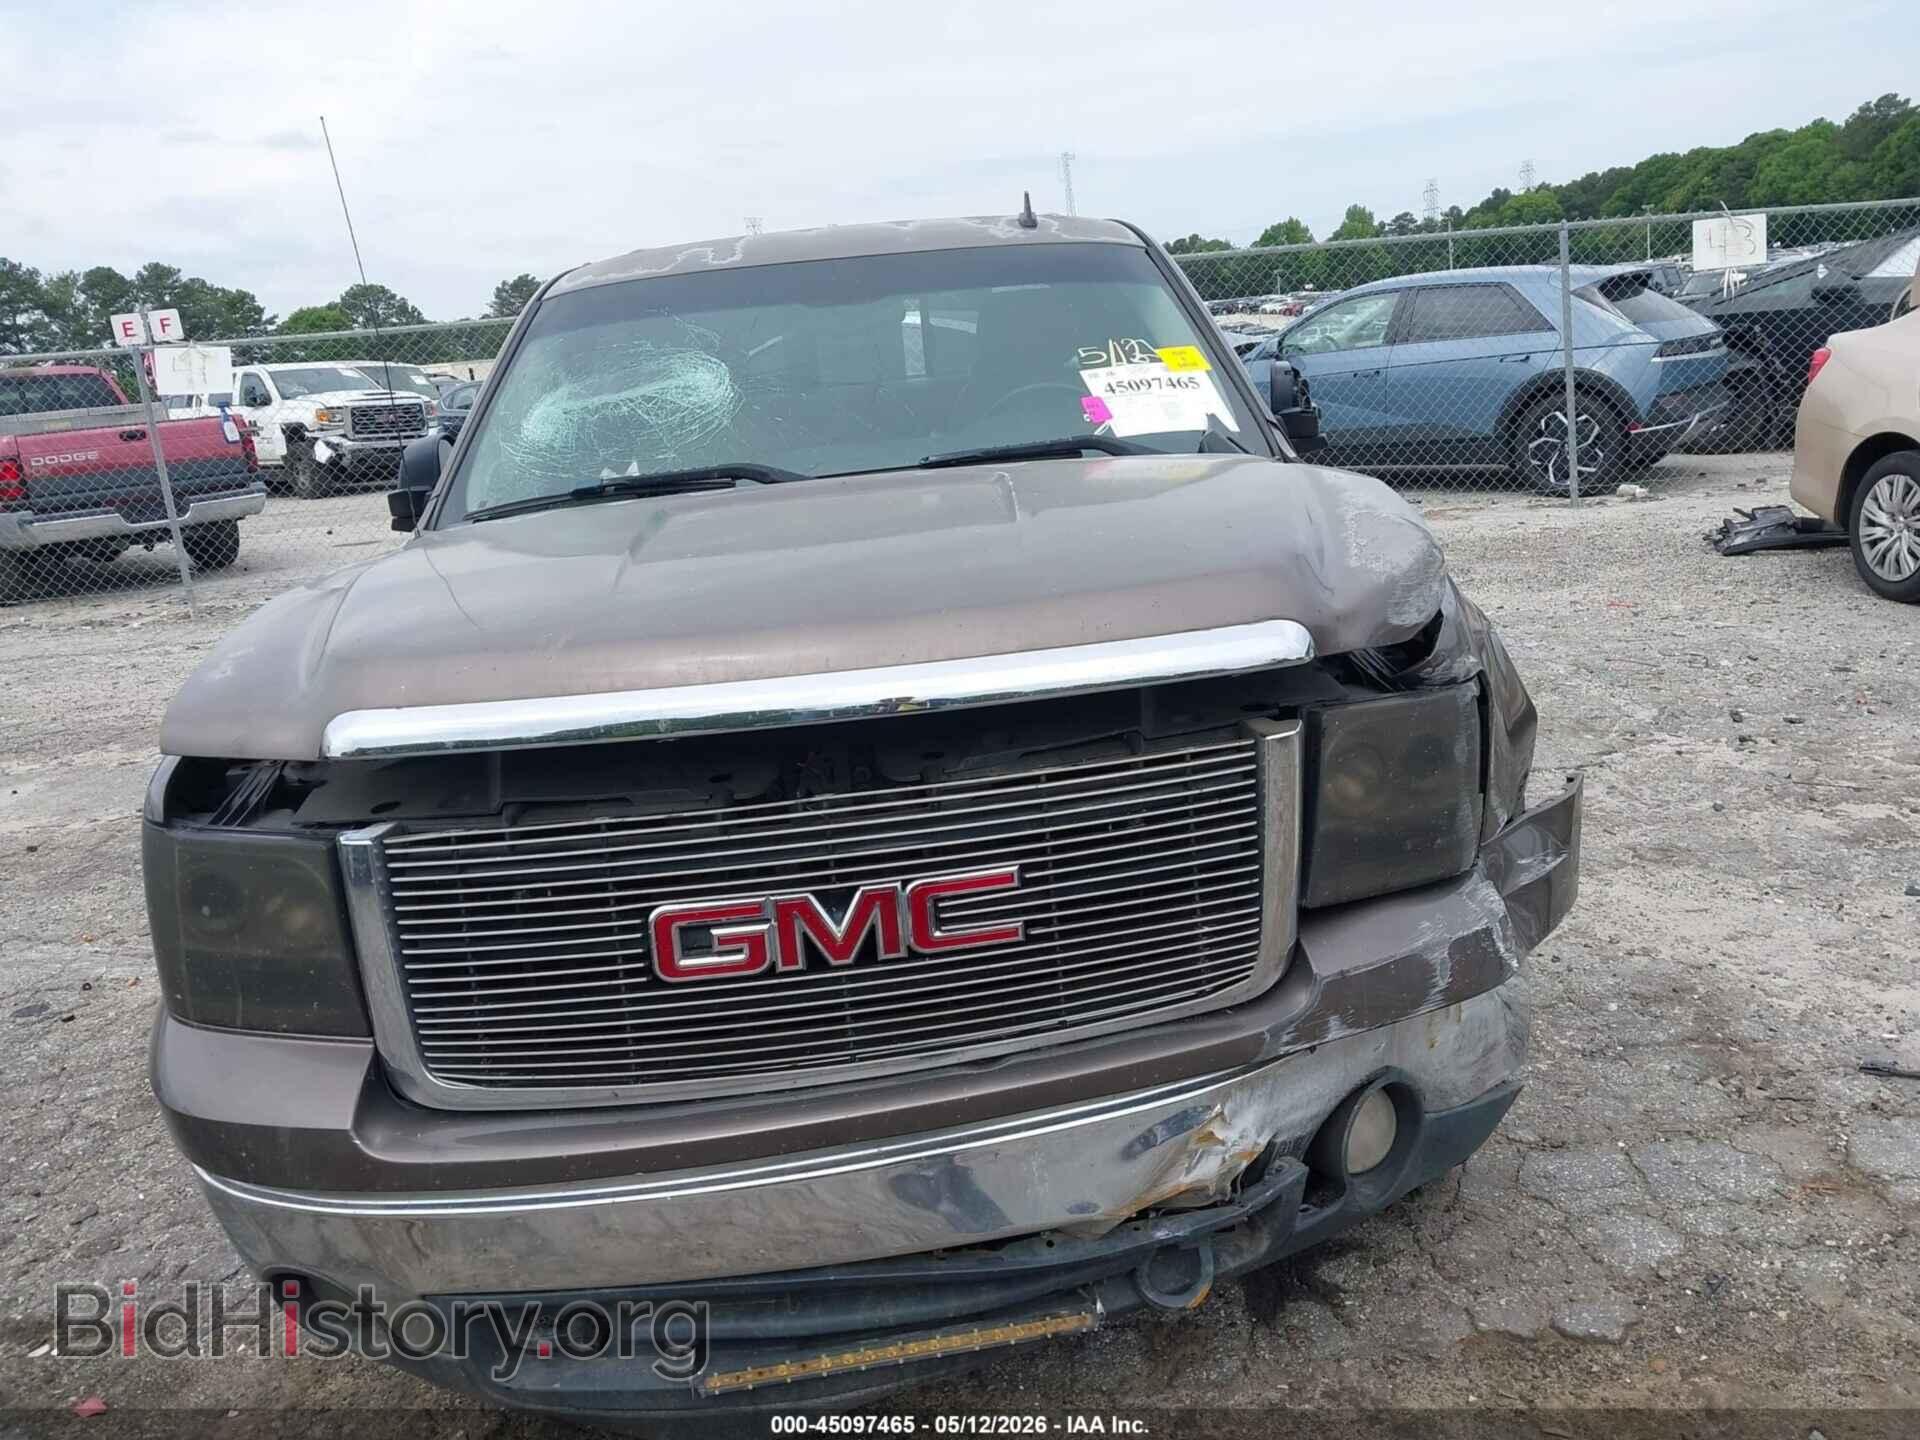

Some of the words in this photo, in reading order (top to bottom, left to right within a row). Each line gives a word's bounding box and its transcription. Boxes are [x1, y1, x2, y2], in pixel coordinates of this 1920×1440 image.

[121, 321, 137, 338] E
[159, 317, 172, 334] F
[1104, 376, 1201, 395] 45097465
[30, 450, 99, 466] DODGE
[647, 865, 1025, 983] GMC
